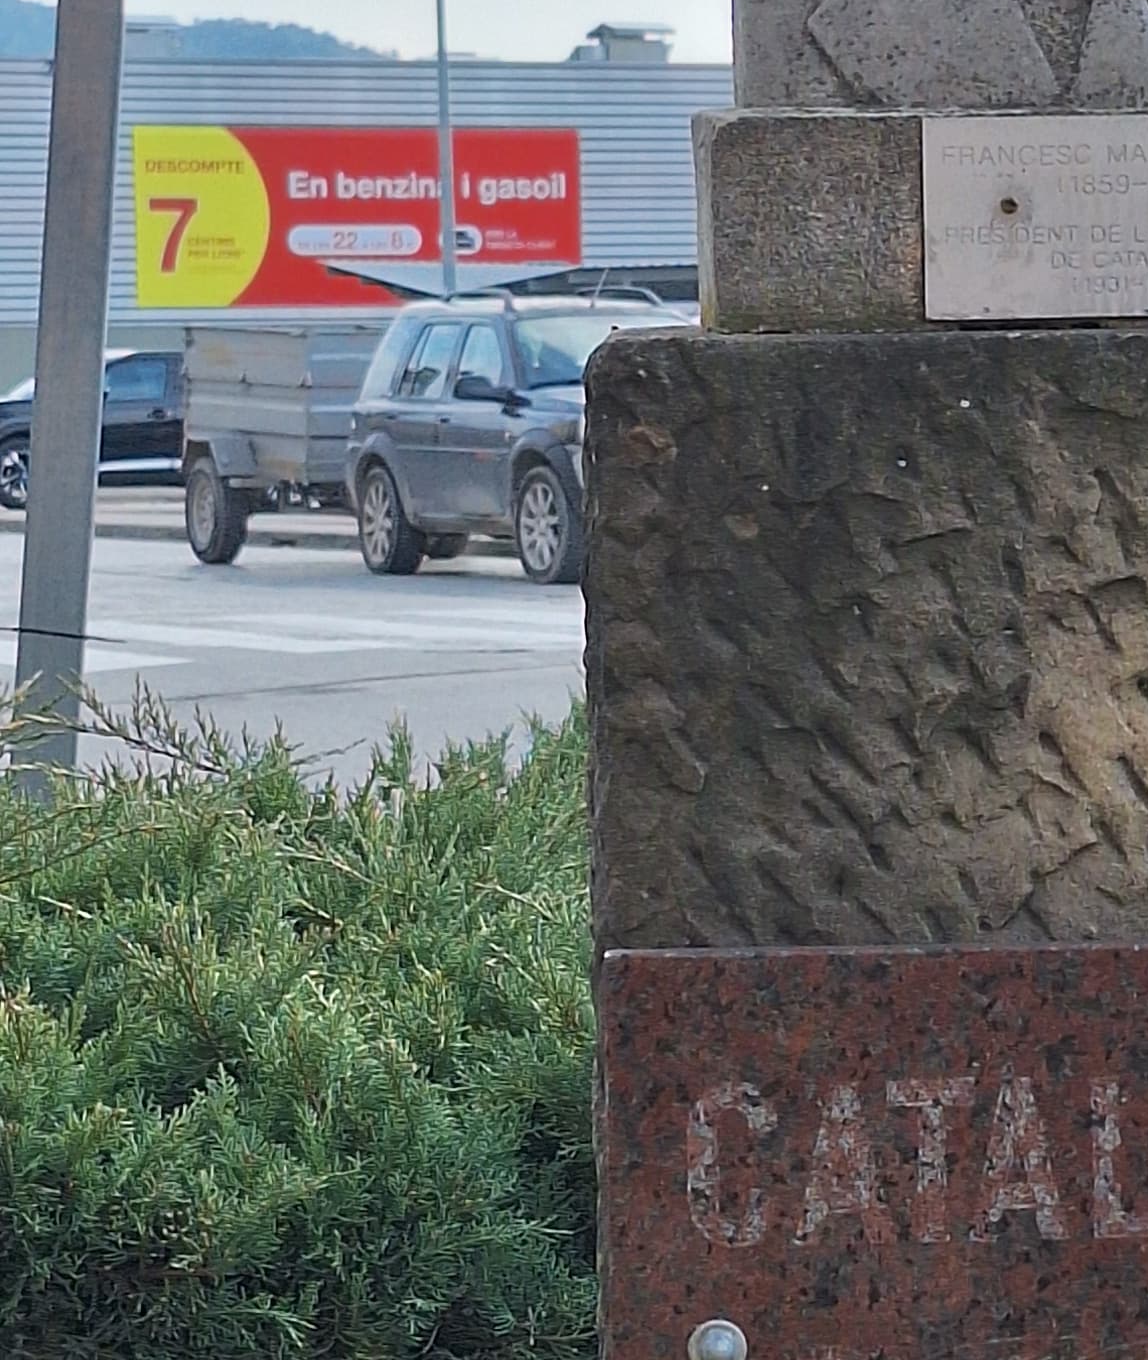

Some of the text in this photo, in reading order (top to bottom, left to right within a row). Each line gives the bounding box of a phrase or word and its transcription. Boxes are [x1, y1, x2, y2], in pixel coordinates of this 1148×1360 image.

[941, 144, 1092, 166] FRANCESC
[144, 159, 246, 175] DESCOMPTE
[288, 170, 328, 200] En
[460, 171, 470, 200] i
[478, 172, 566, 206] gasoil
[148, 197, 199, 274] 7
[333, 231, 358, 250] 22
[944, 225, 1079, 245] PRESIDENT
[1091, 225, 1121, 244] DE
[1051, 250, 1081, 269] DE
